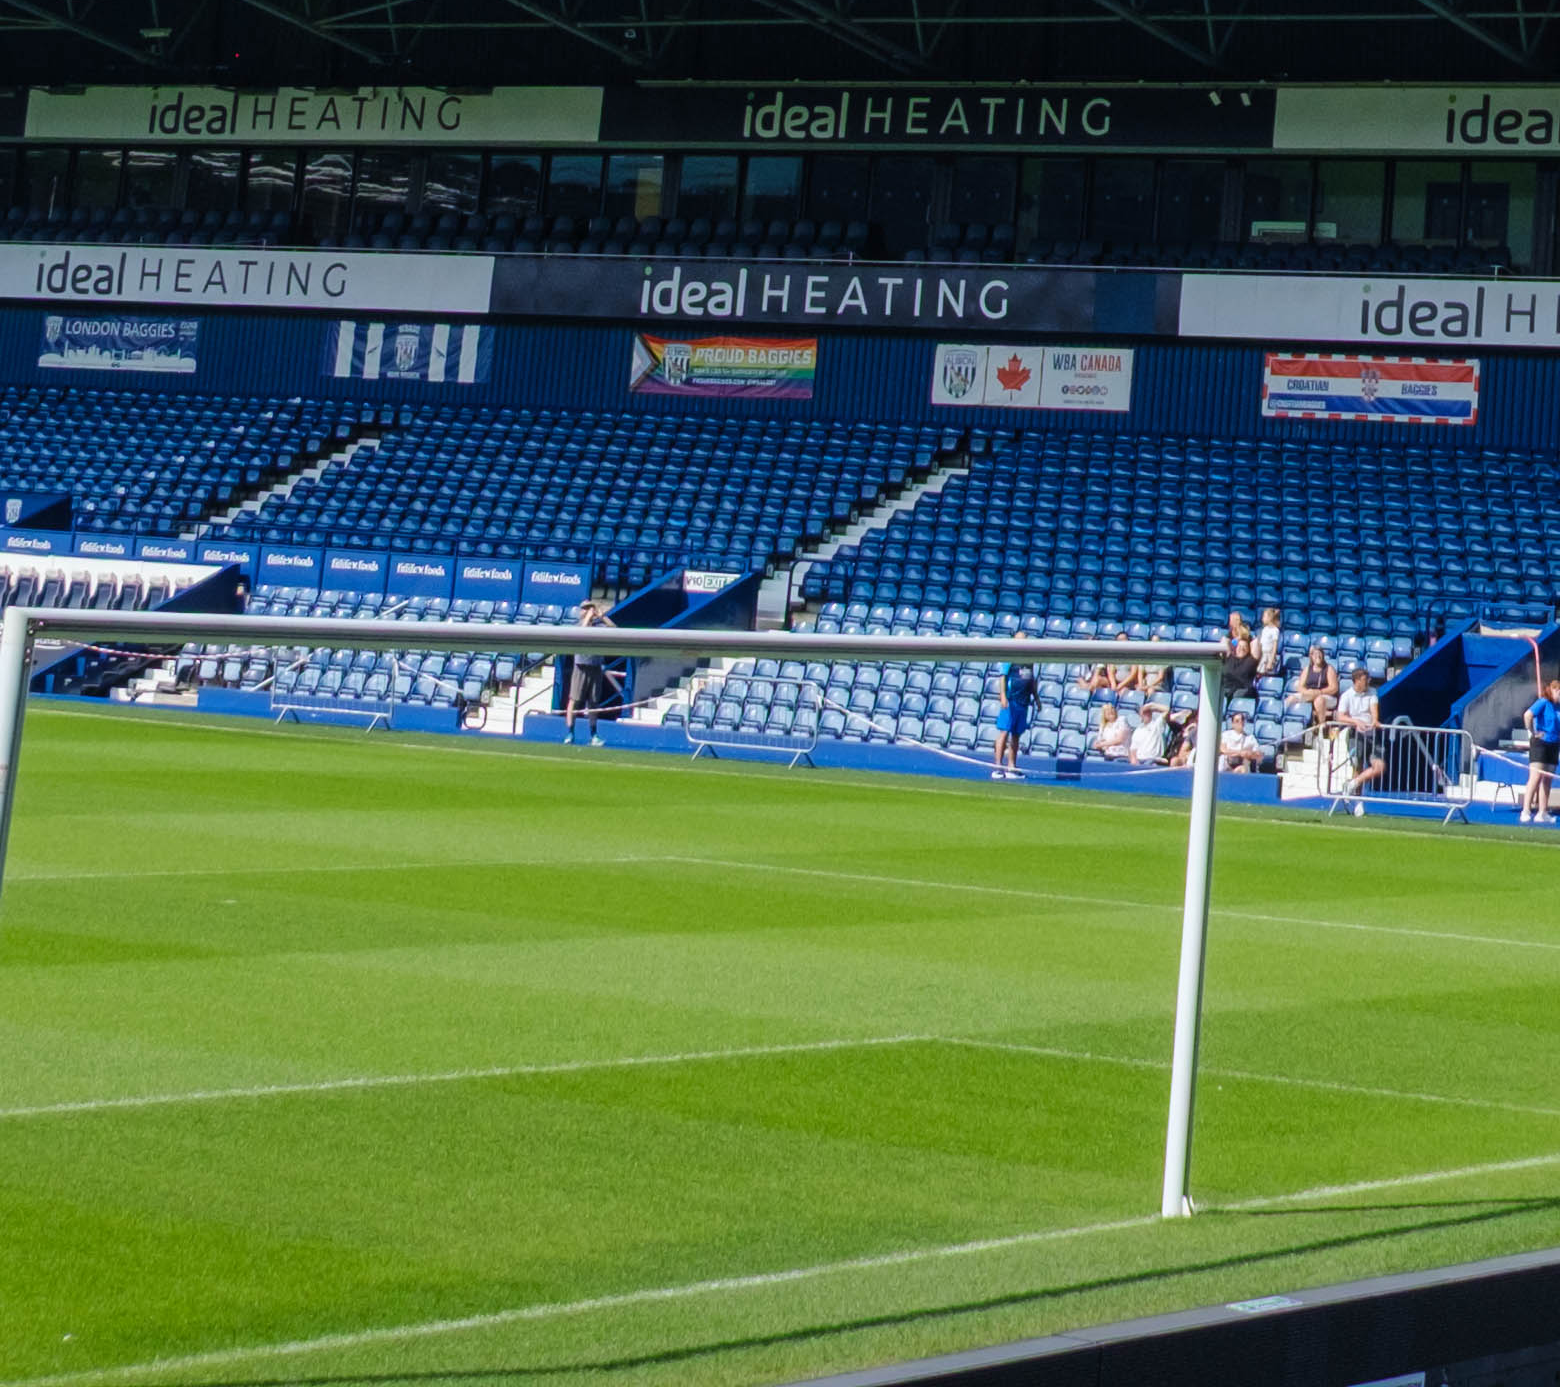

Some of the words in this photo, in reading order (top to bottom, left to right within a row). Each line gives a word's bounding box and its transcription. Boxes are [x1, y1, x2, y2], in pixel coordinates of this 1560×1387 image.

[148, 91, 239, 135] ideal
[251, 96, 462, 130] HEATING
[744, 91, 849, 139] ideal
[864, 97, 1111, 136] HEATING
[36, 250, 126, 296] ideal
[138, 258, 348, 297] HEATING
[641, 266, 747, 317] ideal
[761, 274, 1009, 319] HEATING
[1361, 284, 1485, 337] ideal
[65, 321, 122, 336] LONDON
[122, 323, 175, 338] BAGGIES
[694, 348, 745, 364] PROUD
[748, 349, 813, 365] BAGGIES
[944, 354, 976, 365] ALBION
[1053, 352, 1077, 370] WBA
[1080, 355, 1122, 372] CANADA
[1287, 379, 1329, 392] CROATIAN
[1401, 383, 1437, 396] BAGGIES
[705, 577, 725, 588] EXIT
